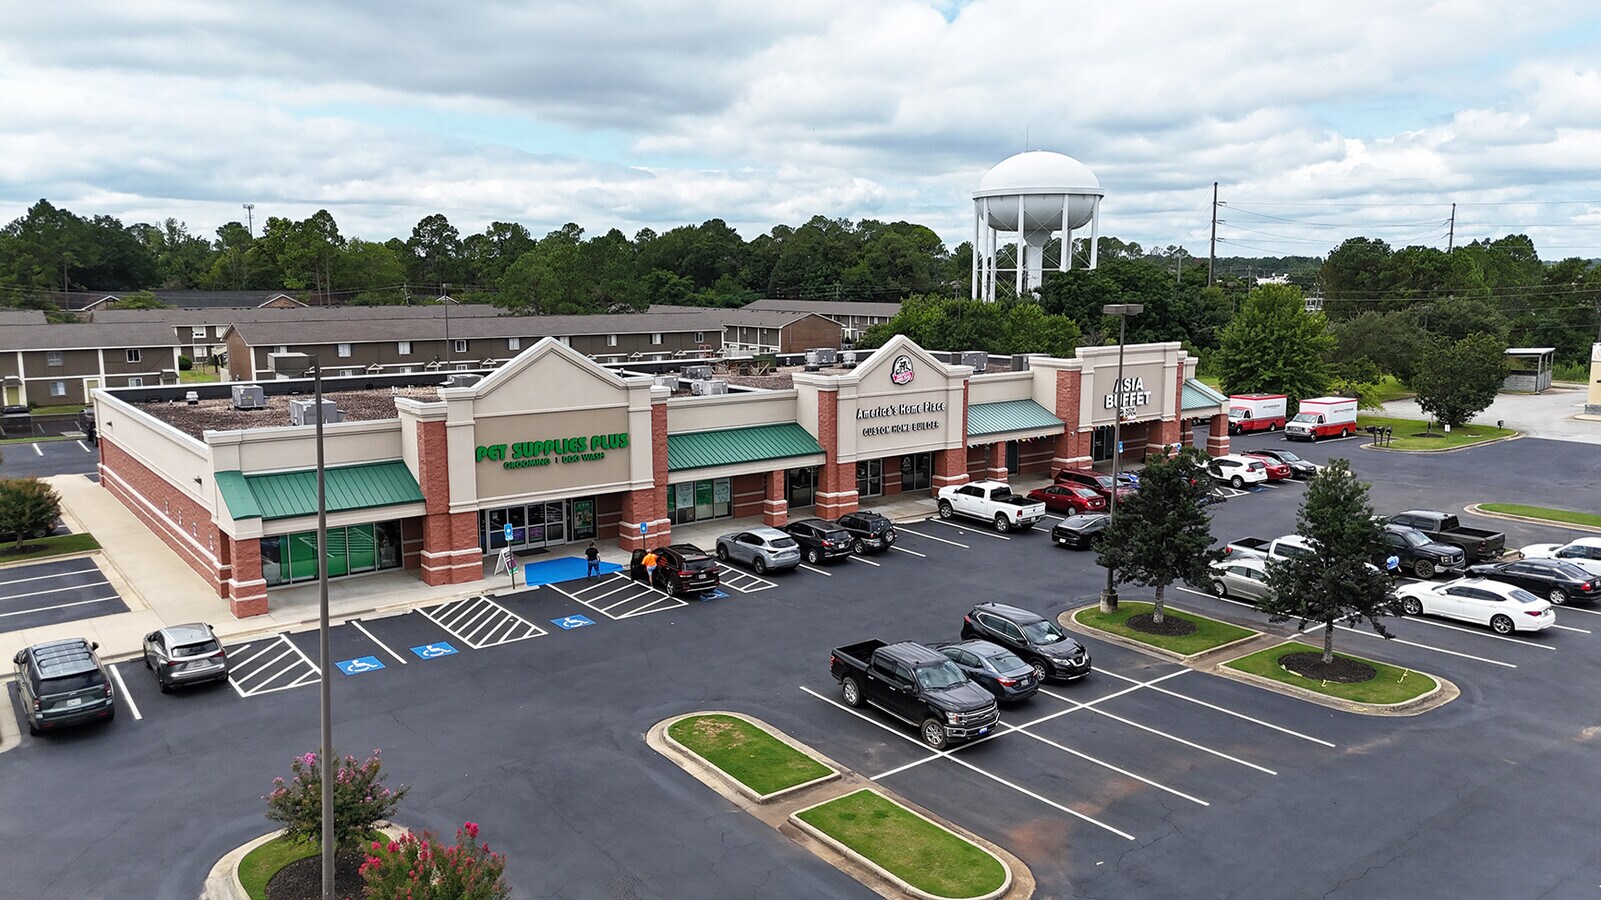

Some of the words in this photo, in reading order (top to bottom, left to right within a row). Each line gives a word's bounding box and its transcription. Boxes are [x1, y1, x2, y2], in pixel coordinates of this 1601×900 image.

[1113, 377, 1144, 393] ASIA
[1104, 391, 1152, 409] BUFFET
[856, 405, 898, 420] America's
[899, 403, 922, 415] Home
[923, 401, 946, 413] Place
[862, 425, 891, 437] CUSTOM
[891, 423, 912, 433] HOME
[911, 420, 940, 431] BUILDER
[475, 444, 508, 463] PET
[511, 436, 588, 459] SUPPLIES
[590, 432, 630, 451] PLUS
[503, 457, 551, 470] GROOMING
[561, 454, 581, 464] DOG
[581, 452, 605, 462] WASH
